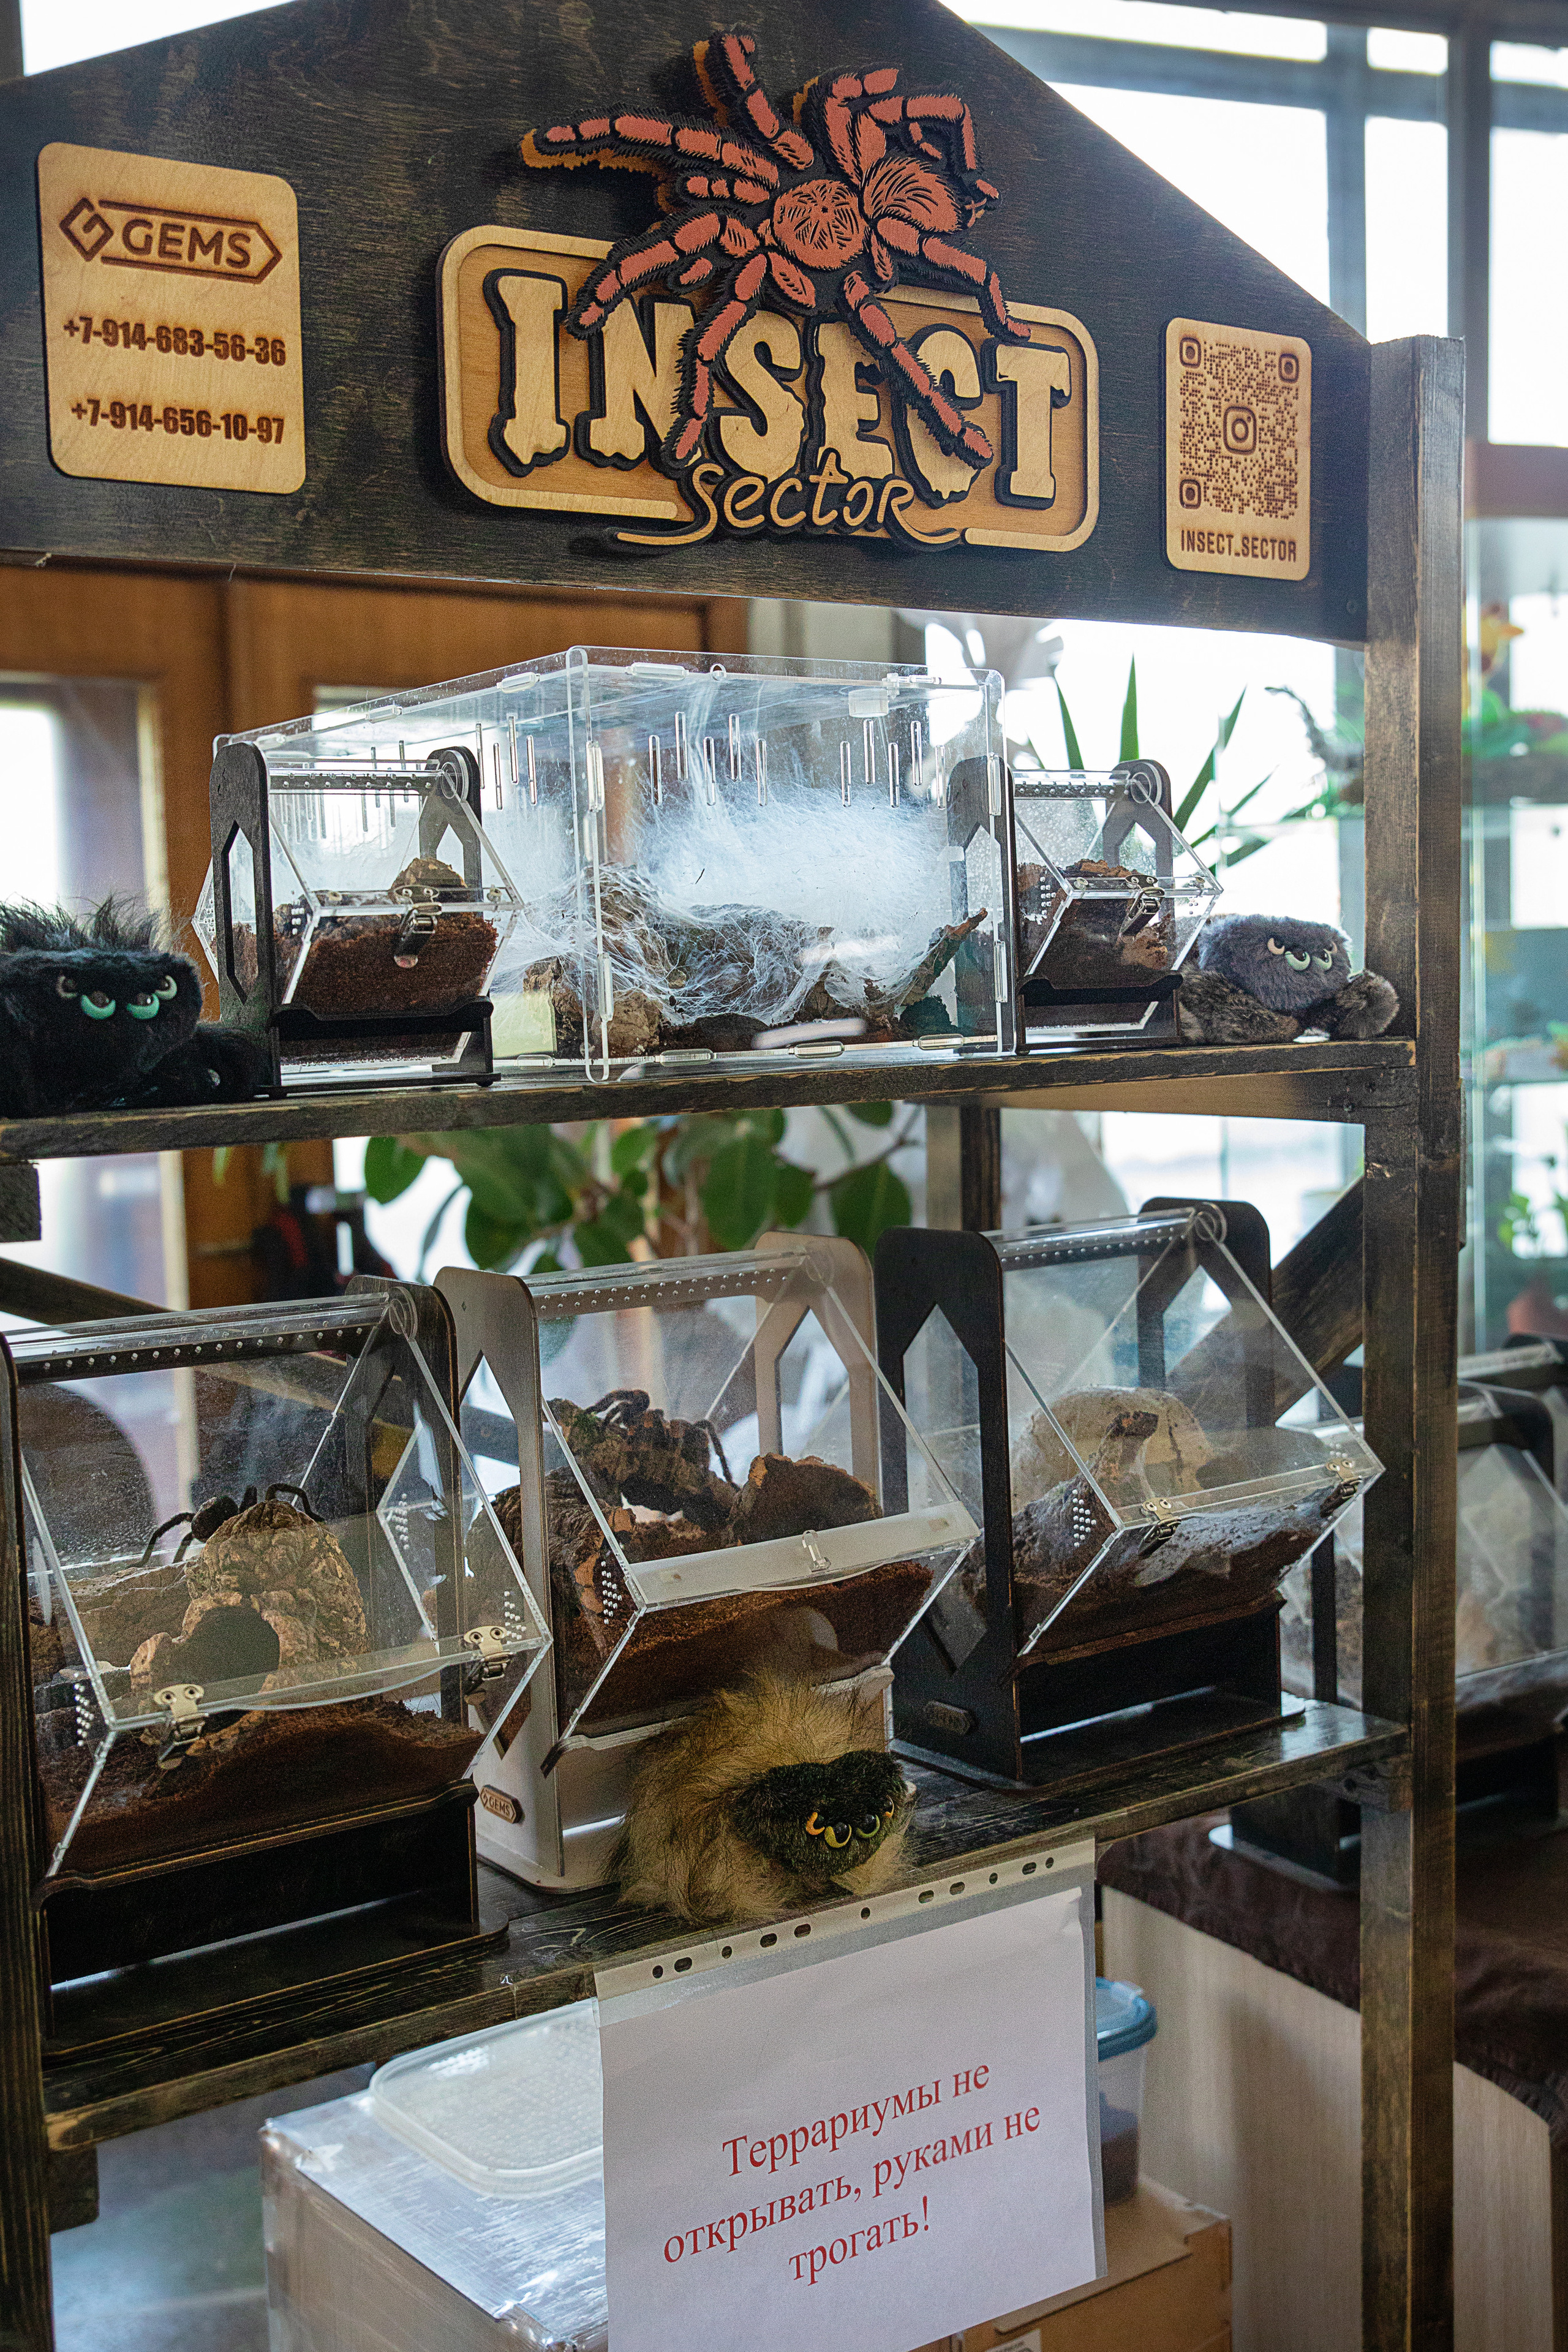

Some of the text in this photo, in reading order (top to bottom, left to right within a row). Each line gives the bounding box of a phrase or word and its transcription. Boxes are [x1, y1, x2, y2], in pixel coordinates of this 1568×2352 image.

[122, 218, 252, 270] GEMS
[62, 315, 287, 367] +7-914-683-56-36
[492, 272, 1072, 501] INSECT
[70, 398, 285, 445] +7-914-656-10-97
[1180, 529, 1297, 563] INSECT_SECTOR
[489, 1795, 510, 1817] GEMS
[722, 2065, 990, 2177] Террариумы не
[663, 2106, 1041, 2264] открывать, руками не
[788, 2195, 930, 2286] трогать!
